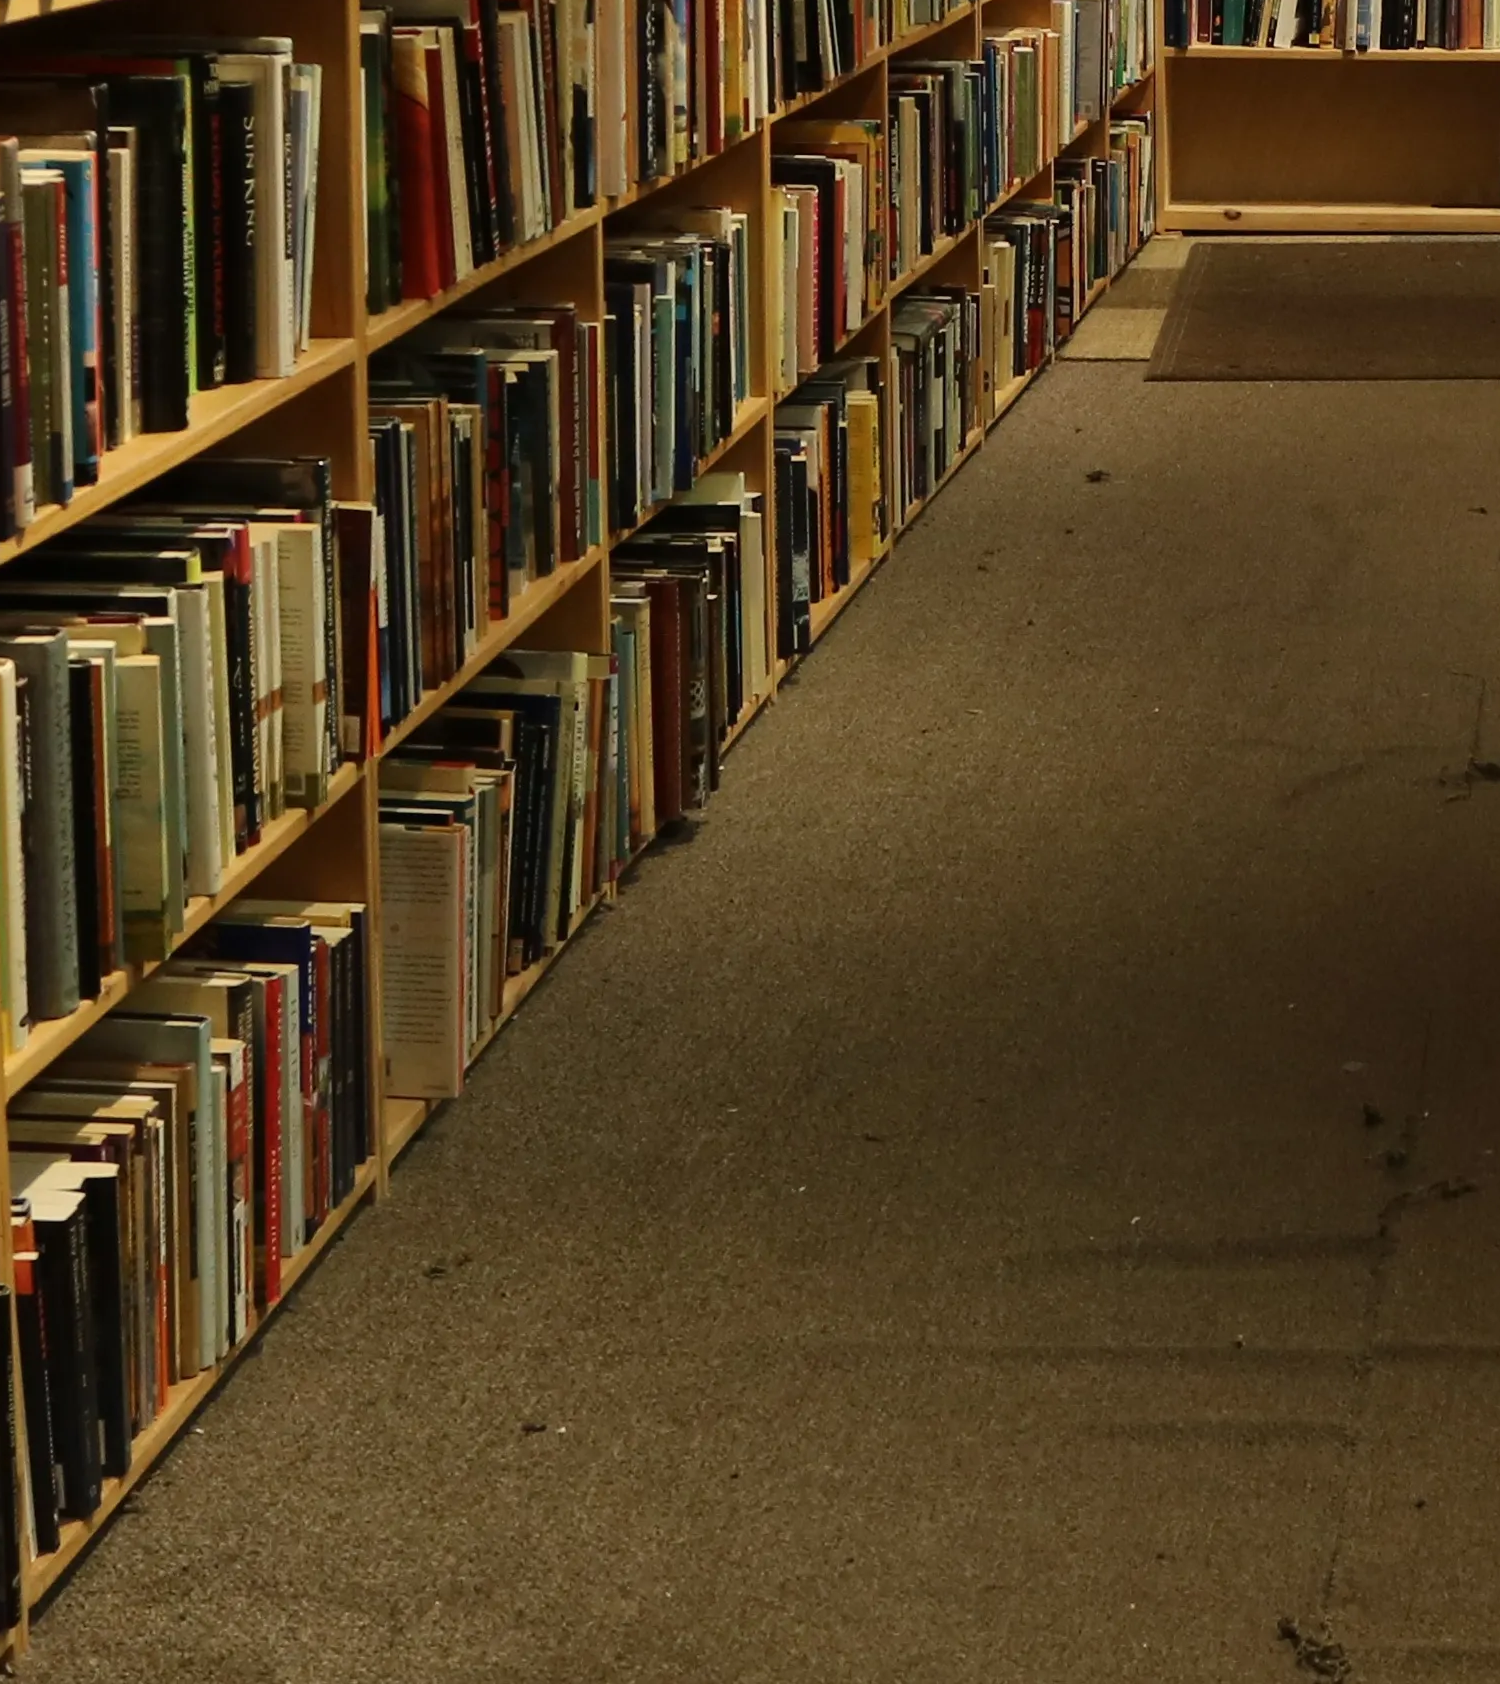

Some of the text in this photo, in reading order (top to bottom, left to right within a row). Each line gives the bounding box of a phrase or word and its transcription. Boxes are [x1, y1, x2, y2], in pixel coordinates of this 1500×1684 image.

[244, 115, 257, 247] SUN KING
[59, 874, 73, 954] MEANY
